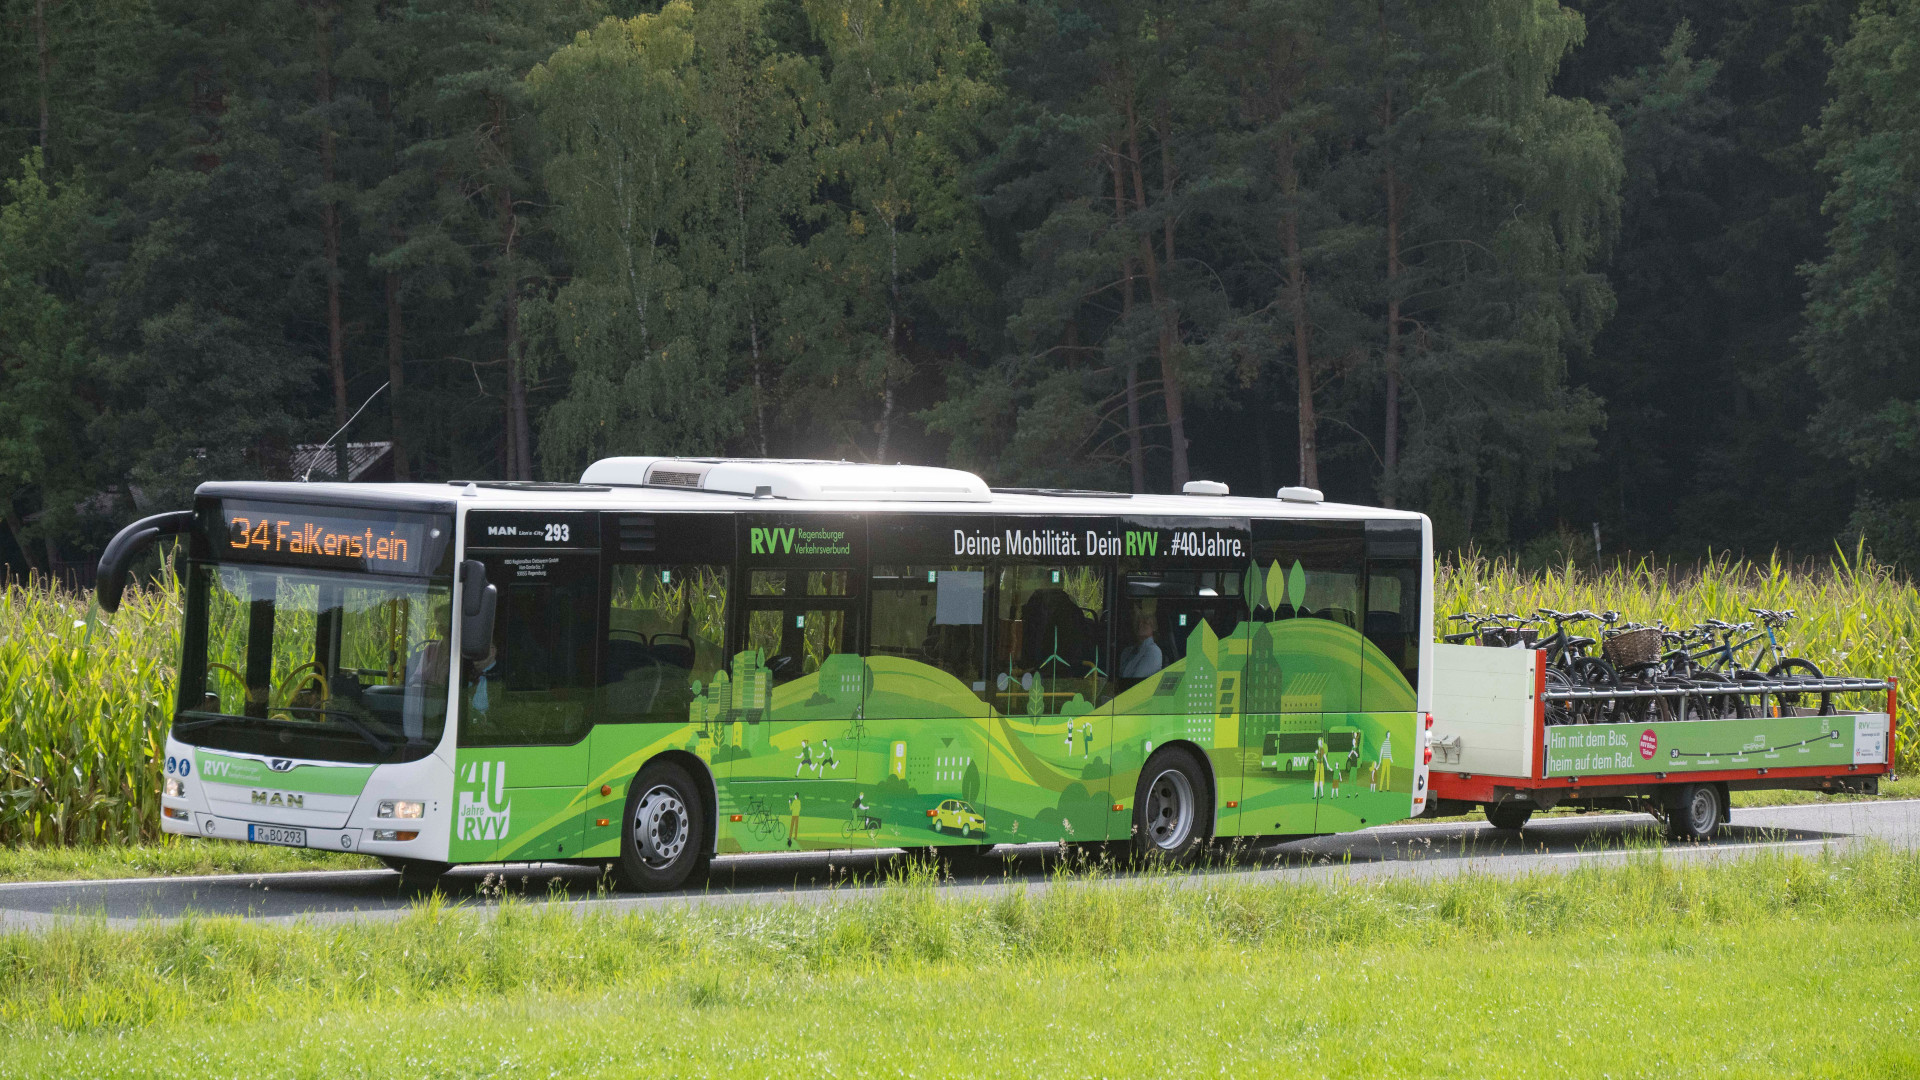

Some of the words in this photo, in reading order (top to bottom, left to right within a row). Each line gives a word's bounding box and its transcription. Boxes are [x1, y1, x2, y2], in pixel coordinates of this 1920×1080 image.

[231, 517, 270, 551] 34
[276, 520, 407, 562] Falkenstein
[487, 526, 517, 536] MAN
[544, 523, 570, 542] 293
[750, 527, 796, 554] RVV
[798, 528, 845, 542] Regensburger
[794, 543, 850, 555] Verkehrsverbund
[953, 529, 1001, 555] Deine
[1005, 529, 1081, 556] Mobilität.
[1086, 530, 1122, 556] Dein
[1551, 732, 1567, 749] Hin
[1568, 731, 1585, 748] mit
[1586, 730, 1606, 747] dem
[1608, 730, 1629, 748] Bus,
[203, 759, 231, 777] RVV
[1293, 756, 1309, 767] RVV
[1550, 754, 1573, 772] heim
[1575, 754, 1592, 770] auf
[1592, 752, 1613, 770] dem
[1614, 752, 1635, 768] Rad.
[251, 790, 304, 808] MAN
[461, 804, 485, 817] Jahre
[258, 828, 264, 840] R
[463, 816, 507, 841] RVV
